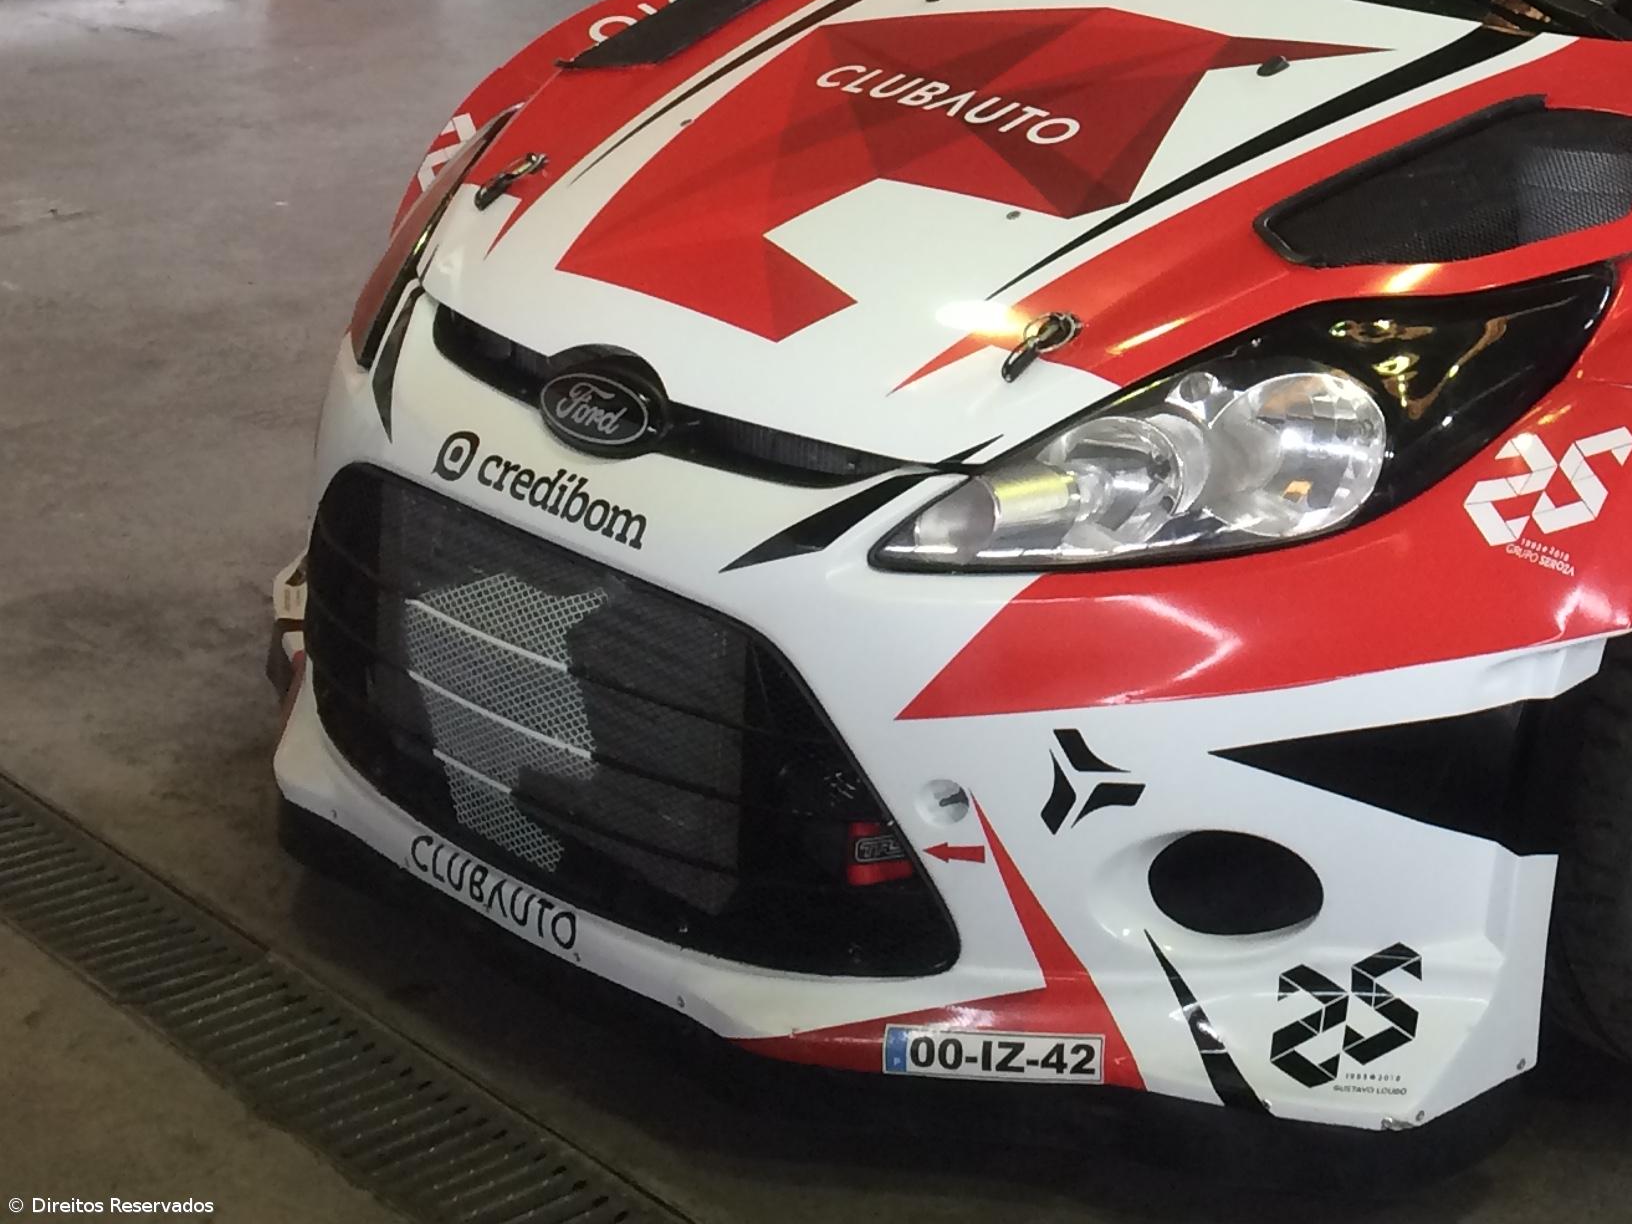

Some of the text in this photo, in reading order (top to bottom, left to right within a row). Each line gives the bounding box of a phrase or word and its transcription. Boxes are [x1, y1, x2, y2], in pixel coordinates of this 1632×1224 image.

[816, 64, 1081, 145] CLUBAUTO
[555, 381, 629, 435] Ford
[476, 454, 648, 550] credibom
[411, 835, 577, 950] CLUBAUTO
[909, 1035, 1096, 1075] 00-IZ-42
